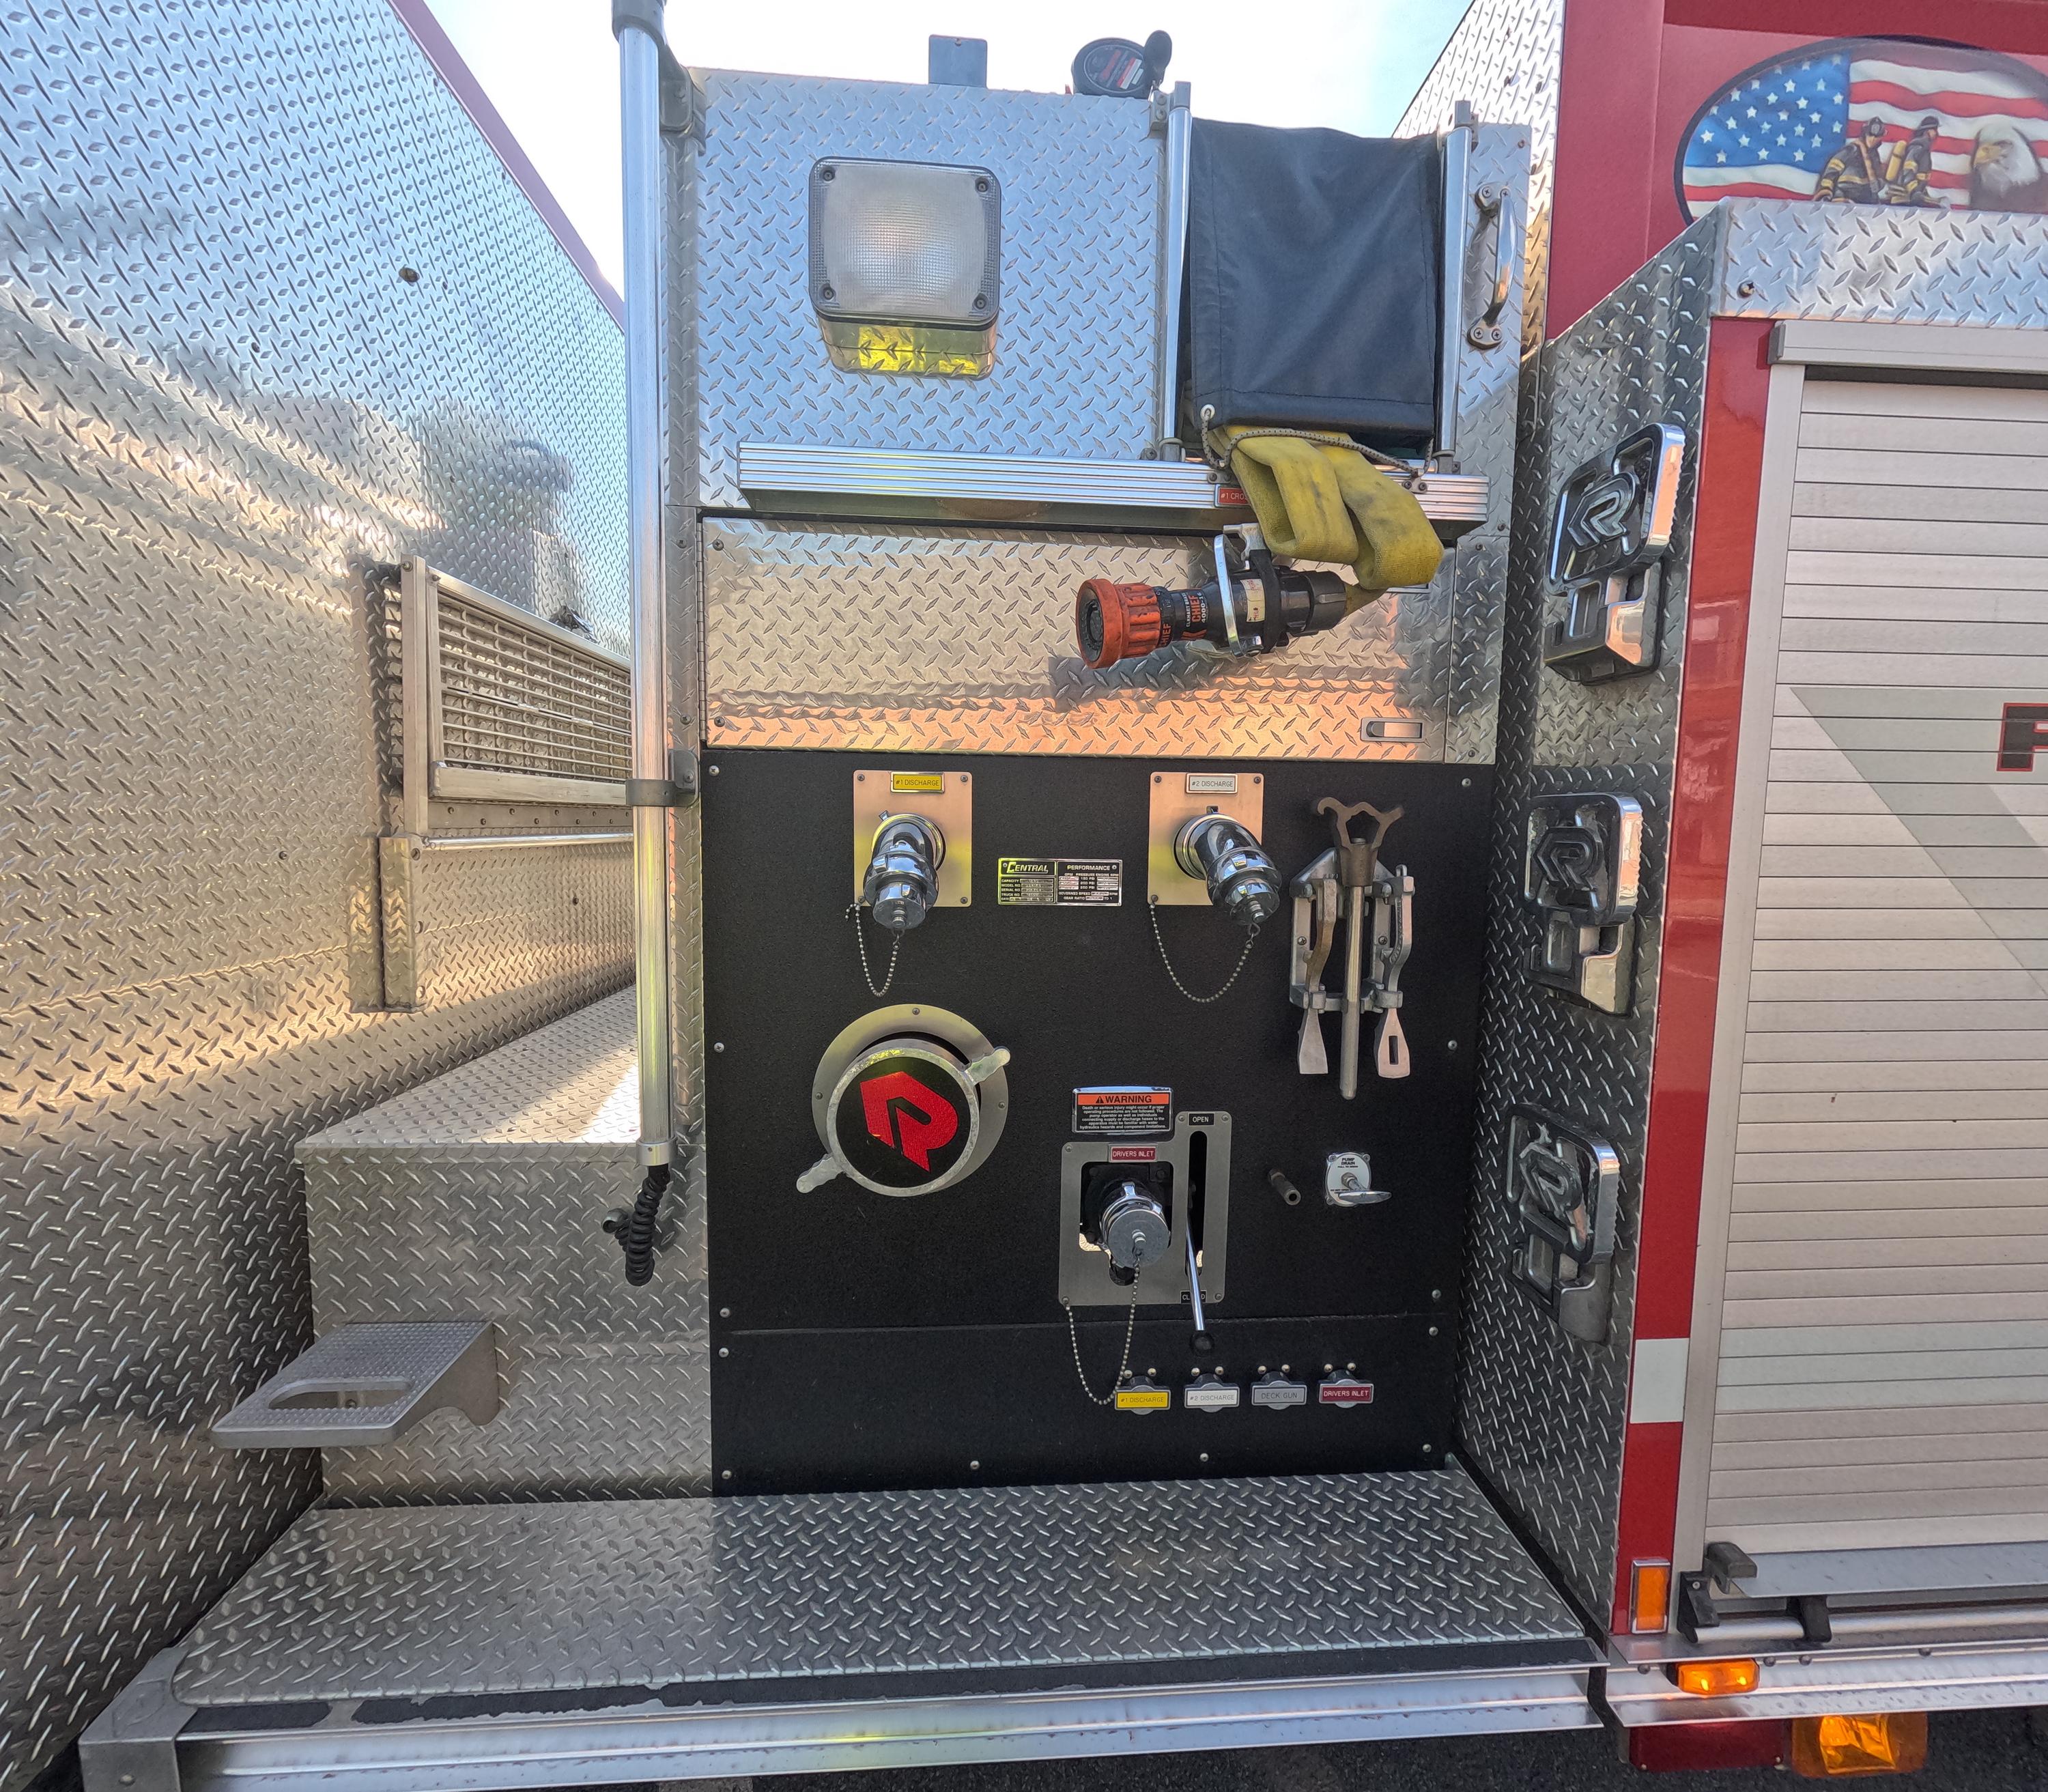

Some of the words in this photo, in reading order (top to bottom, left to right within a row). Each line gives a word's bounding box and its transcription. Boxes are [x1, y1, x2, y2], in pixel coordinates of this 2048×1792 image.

[1181, 593, 1189, 605] BRASS
[1188, 595, 1201, 623] CHIEF
[1197, 592, 1206, 623] 4000-16
[1006, 862, 1049, 874] CENTRAL
[1105, 1095, 1152, 1104] WARNING
